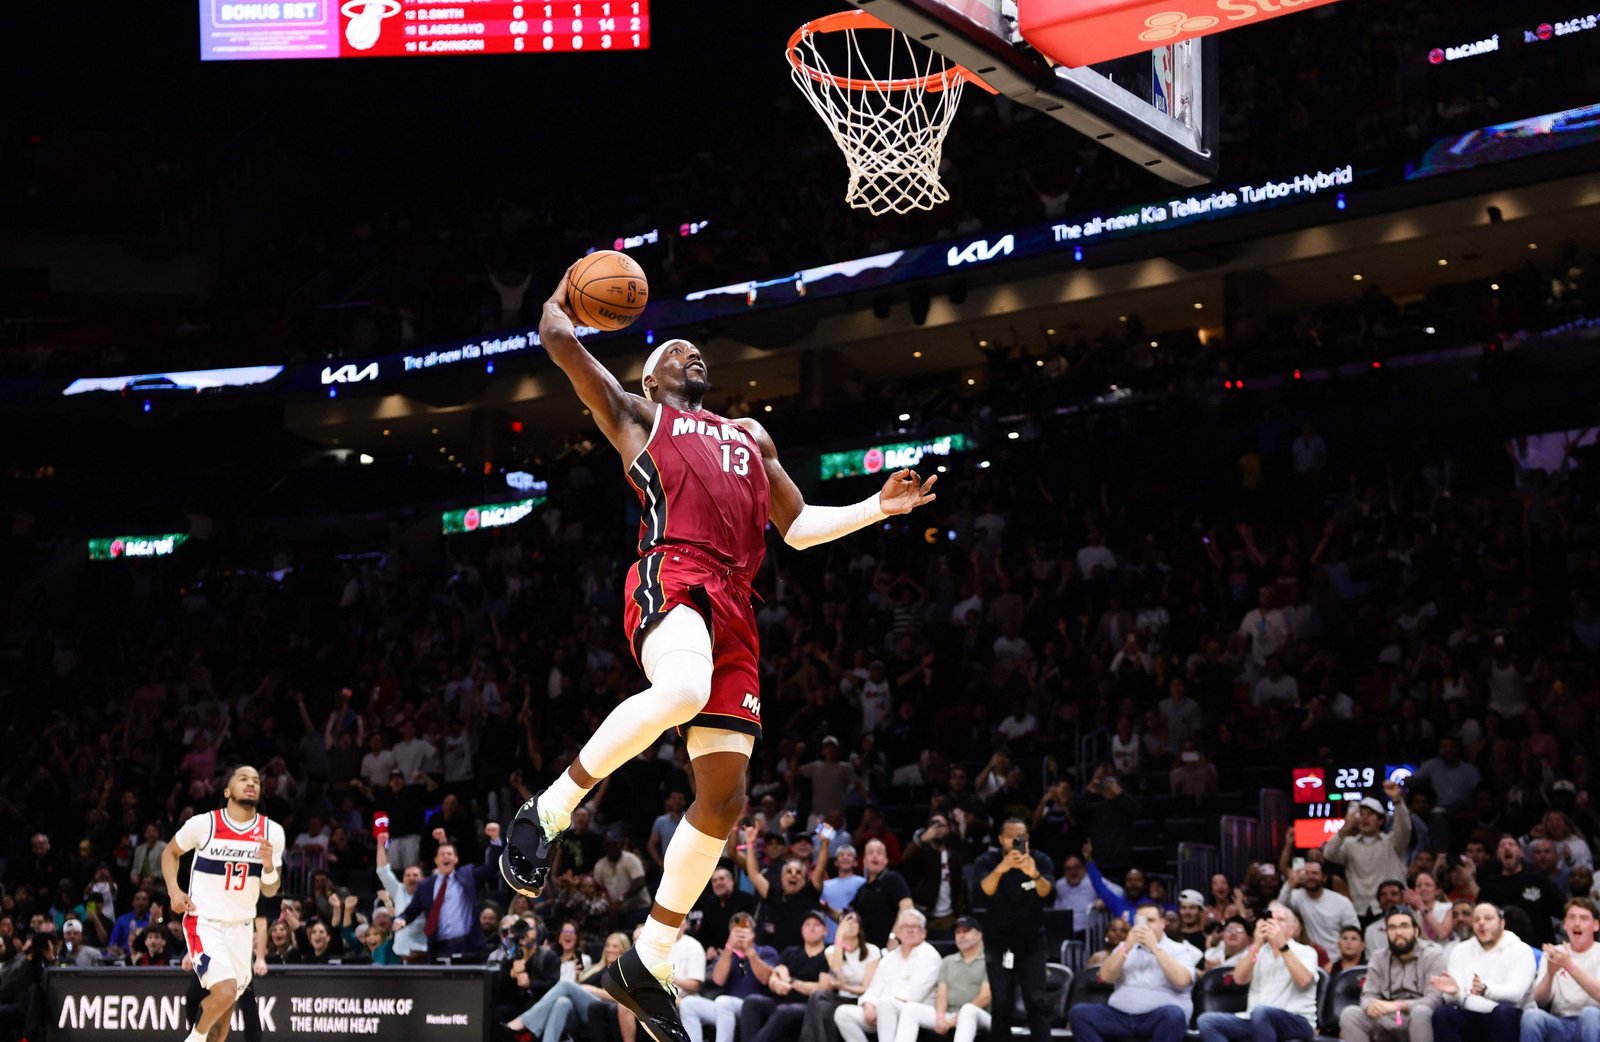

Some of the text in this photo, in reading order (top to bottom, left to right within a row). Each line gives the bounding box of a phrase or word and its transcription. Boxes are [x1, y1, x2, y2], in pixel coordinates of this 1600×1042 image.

[221, 2, 318, 20] BONUS BET
[543, 4, 552, 18] 1
[573, 3, 582, 17] 1
[602, 2, 610, 16] 1
[631, 2, 639, 15] 1
[598, 18, 615, 32] 14
[630, 17, 641, 31] 2
[514, 37, 524, 51] 5
[601, 34, 612, 49] 3
[632, 33, 640, 47] 1
[1053, 166, 1353, 242] The all-new Kia Telluride Turbo-Hybrid
[403, 355, 423, 372] The
[424, 350, 461, 367] all-new
[462, 344, 480, 359] Kia
[481, 335, 526, 356] Telluride
[672, 417, 749, 445] MIAMI
[720, 444, 750, 476] 13
[1335, 768, 1375, 788] 22.9
[1308, 803, 1330, 818] 111
[210, 845, 263, 860] wizard
[224, 861, 249, 891] 13
[58, 995, 190, 1031] AMERAN
[290, 997, 414, 1016] THE OFFICIAL BANK OF
[290, 1016, 380, 1034] THE MIAMI HEAT
